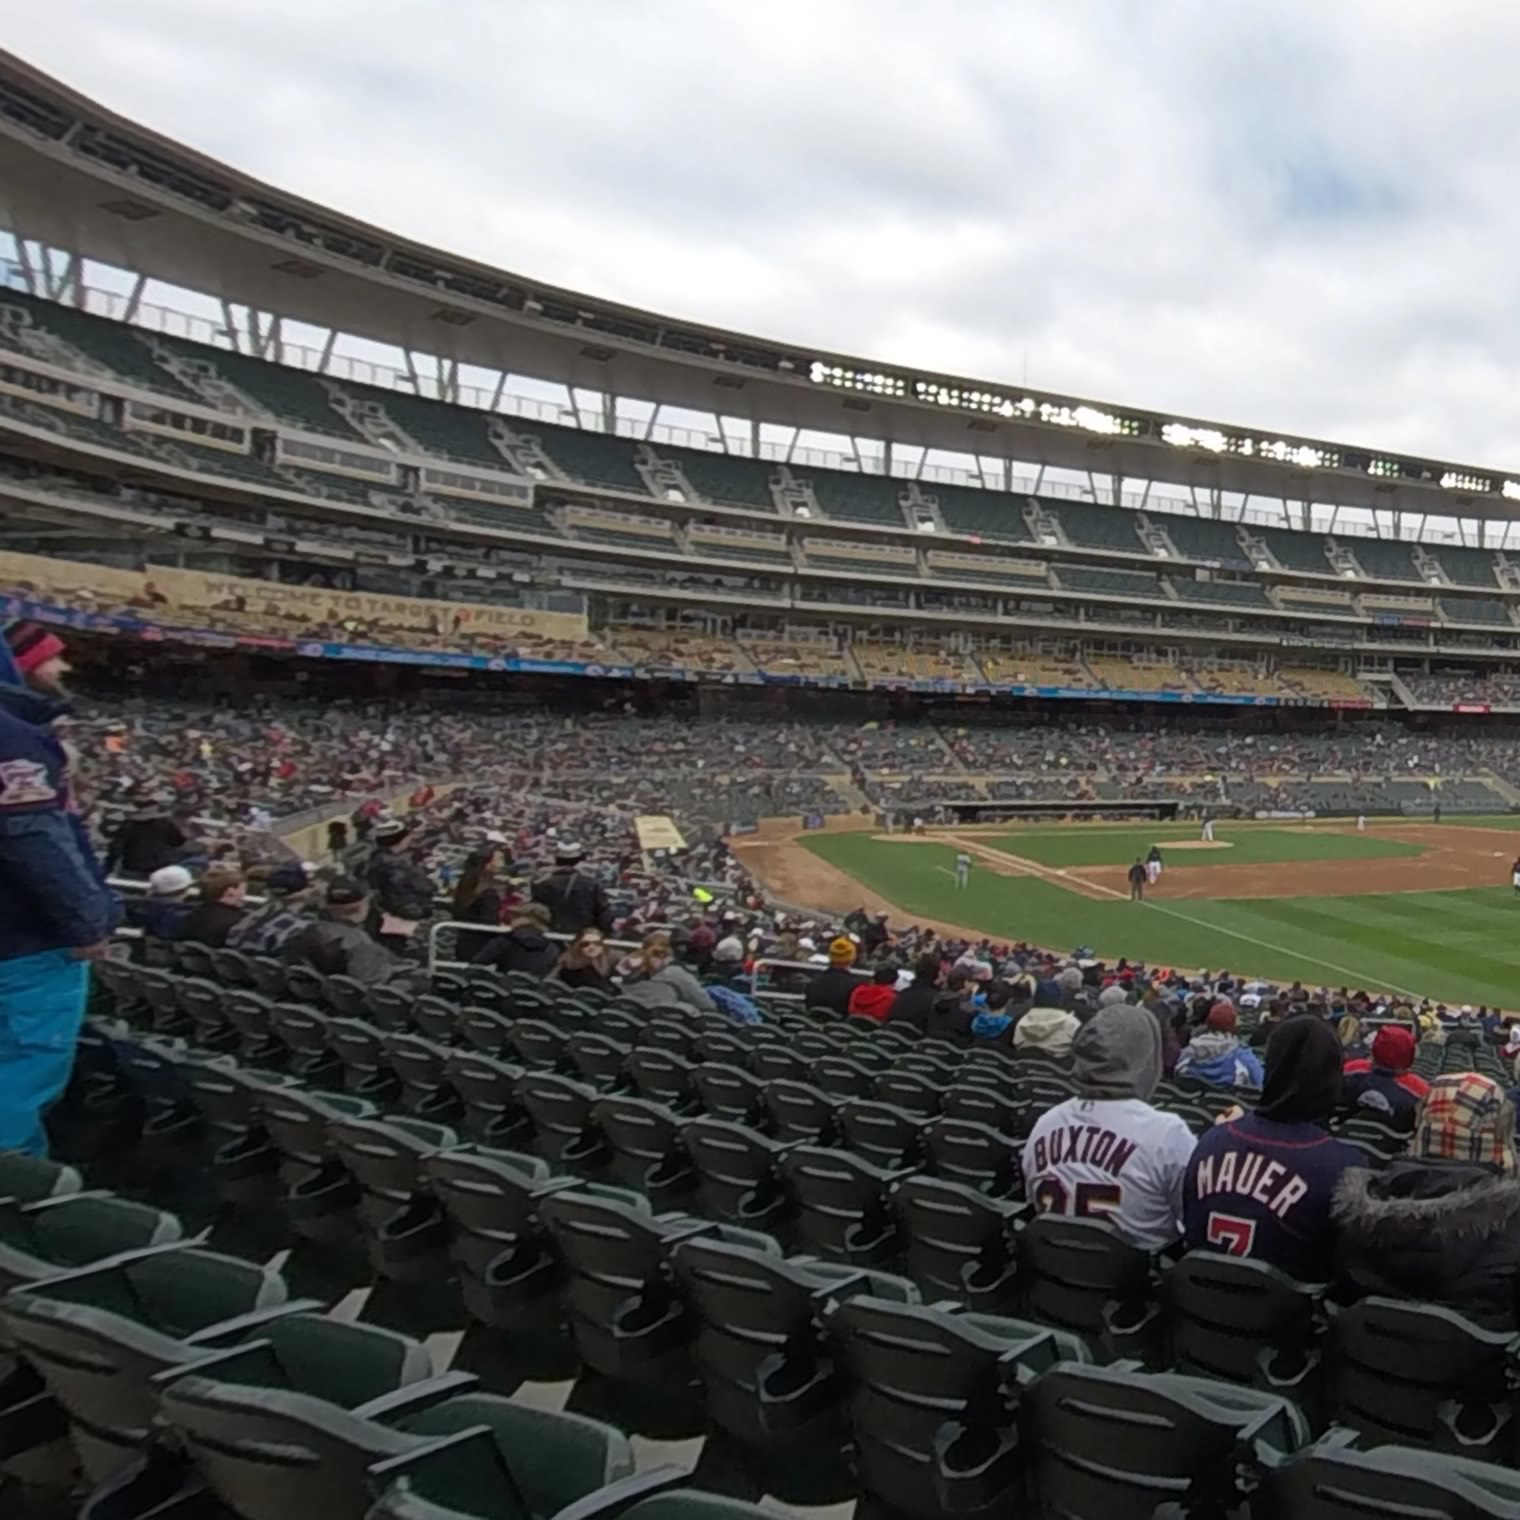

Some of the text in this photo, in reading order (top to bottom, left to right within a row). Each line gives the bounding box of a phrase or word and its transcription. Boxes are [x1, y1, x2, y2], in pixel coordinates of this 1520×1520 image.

[1033, 1125, 1137, 1178] BUXTON
[1197, 1151, 1308, 1218] MAUER
[1207, 1211, 1257, 1260] 7
